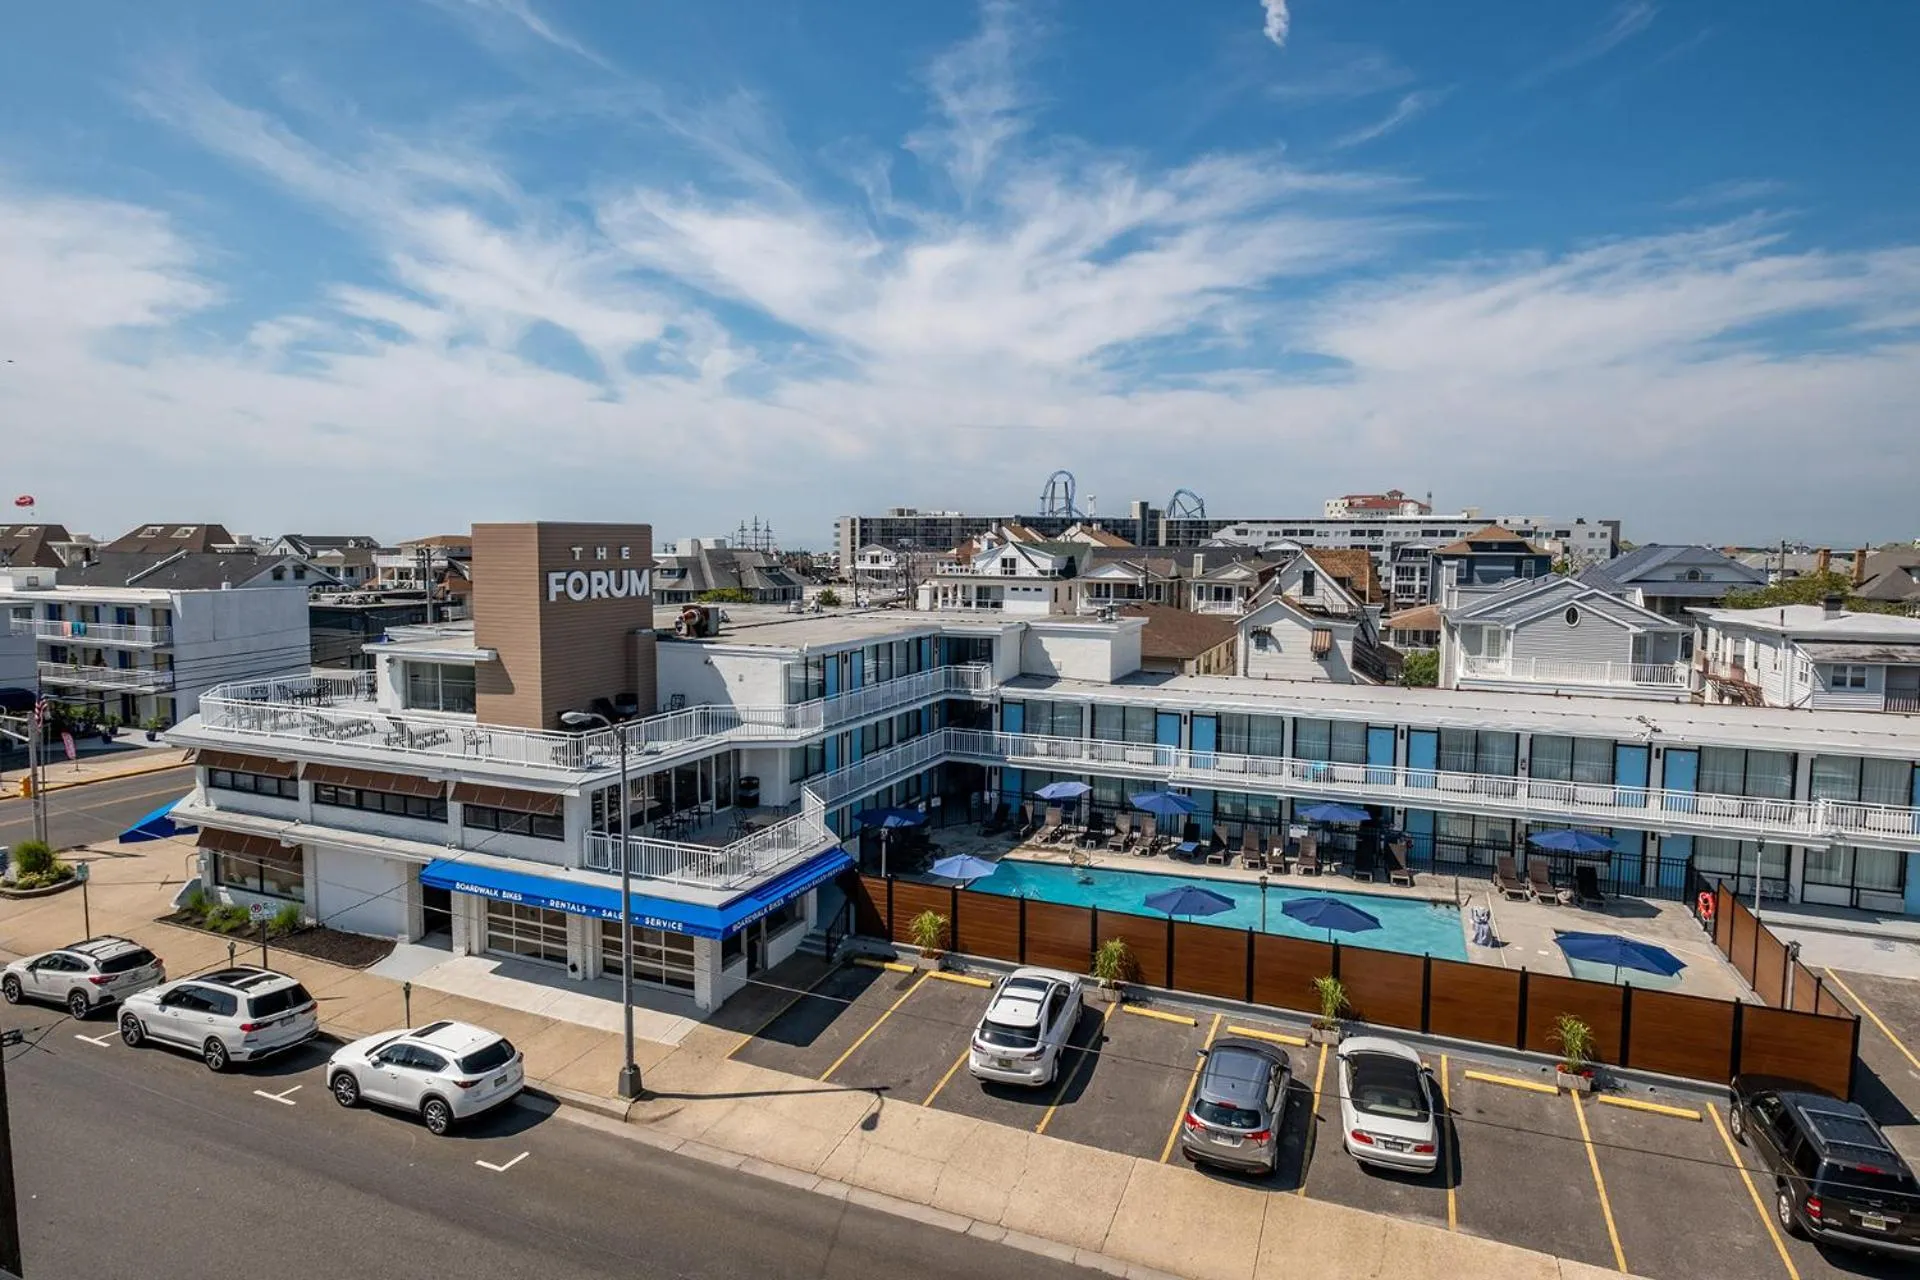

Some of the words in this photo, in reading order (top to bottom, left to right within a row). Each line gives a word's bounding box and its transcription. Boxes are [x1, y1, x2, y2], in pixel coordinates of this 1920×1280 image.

[571, 546, 631, 561] THE
[548, 569, 650, 602] FORUM
[455, 881, 499, 897] BOARDWALK
[502, 890, 523, 901] BIKES
[549, 899, 586, 913] RENTALS
[601, 909, 625, 920] SALE
[644, 917, 683, 931] SERVICE
